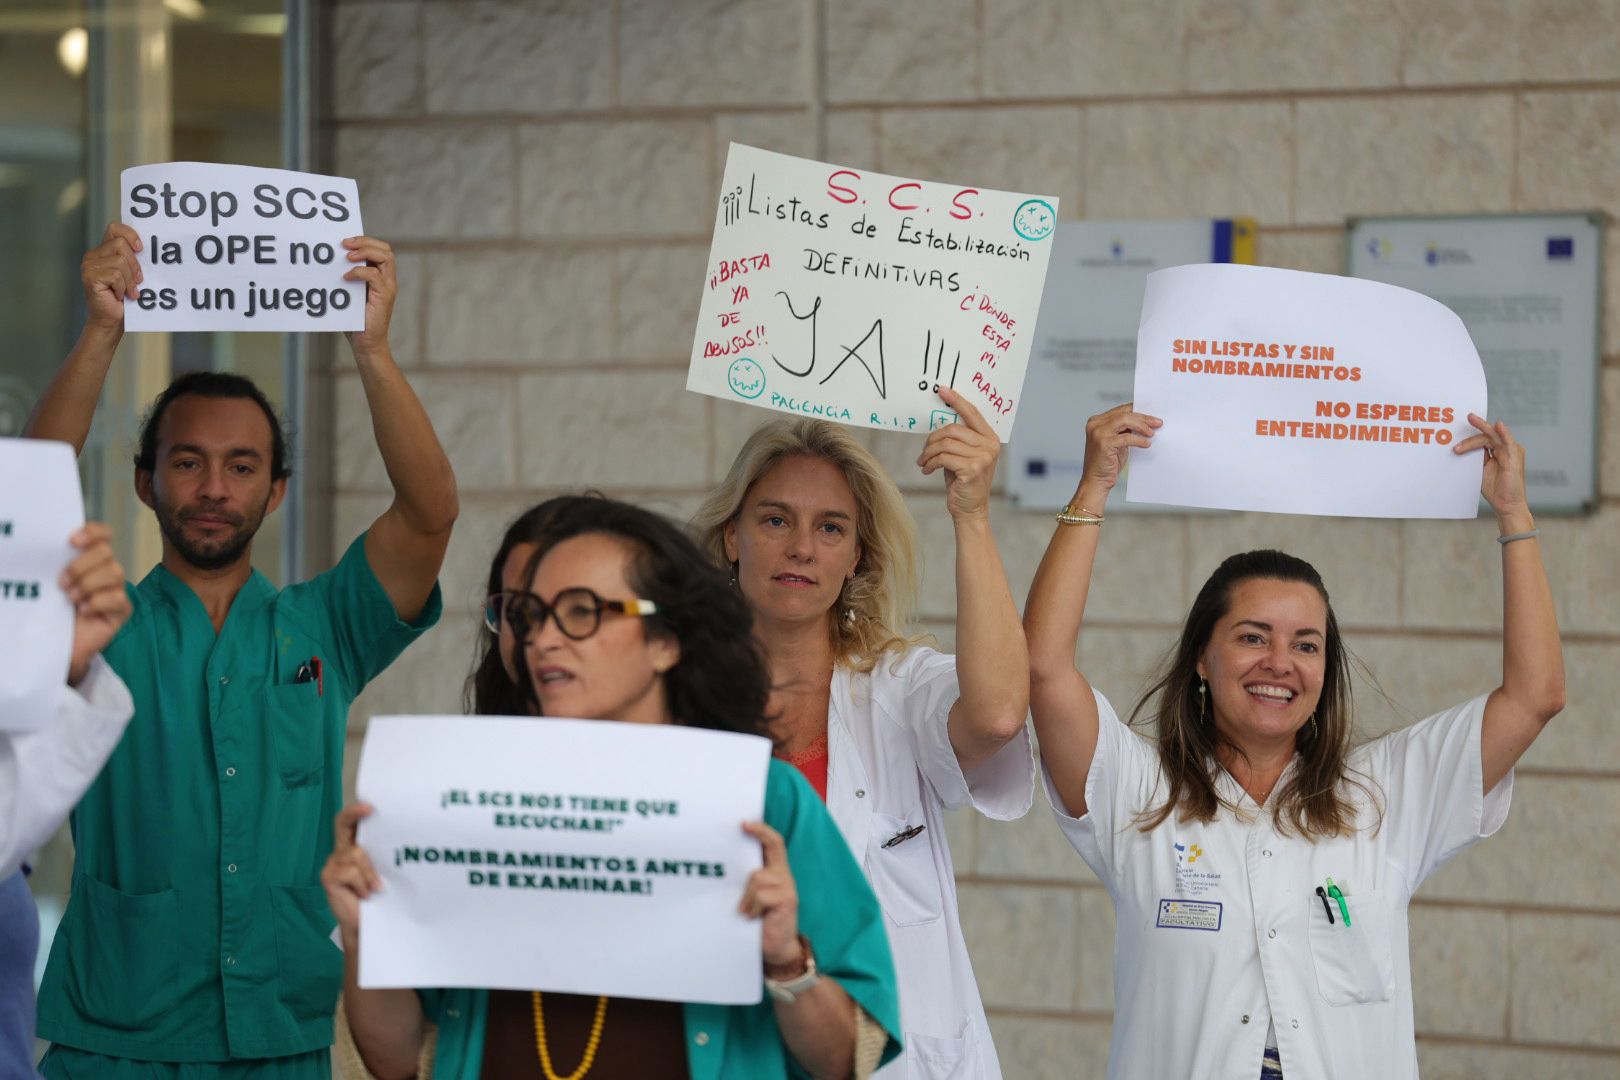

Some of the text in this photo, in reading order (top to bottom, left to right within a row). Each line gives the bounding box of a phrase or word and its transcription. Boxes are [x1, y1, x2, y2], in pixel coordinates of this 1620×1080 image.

[130, 182, 350, 227] Stop SCS
[151, 235, 334, 265] la OPE no
[851, 214, 876, 238] de
[898, 217, 1030, 262] Estabilización
[137, 281, 351, 318] es un juego
[731, 287, 749, 305] YA
[718, 311, 741, 328] DE
[1172, 339, 1334, 361] SIN LISTAS Y SIN
[1172, 359, 1362, 381] NOMBRAMIENTOS
[1315, 400, 1454, 424] NO ESPERES
[1255, 420, 1453, 446] ENTENDIMIENTO
[479, 792, 514, 808] SCS
[520, 793, 563, 810] NOS
[569, 795, 628, 813] TIENE
[635, 799, 679, 817] QUE
[394, 846, 726, 878] ¡NOMBRAMIENTOS ANTES
[469, 871, 653, 896] DE EXAMINAR!
